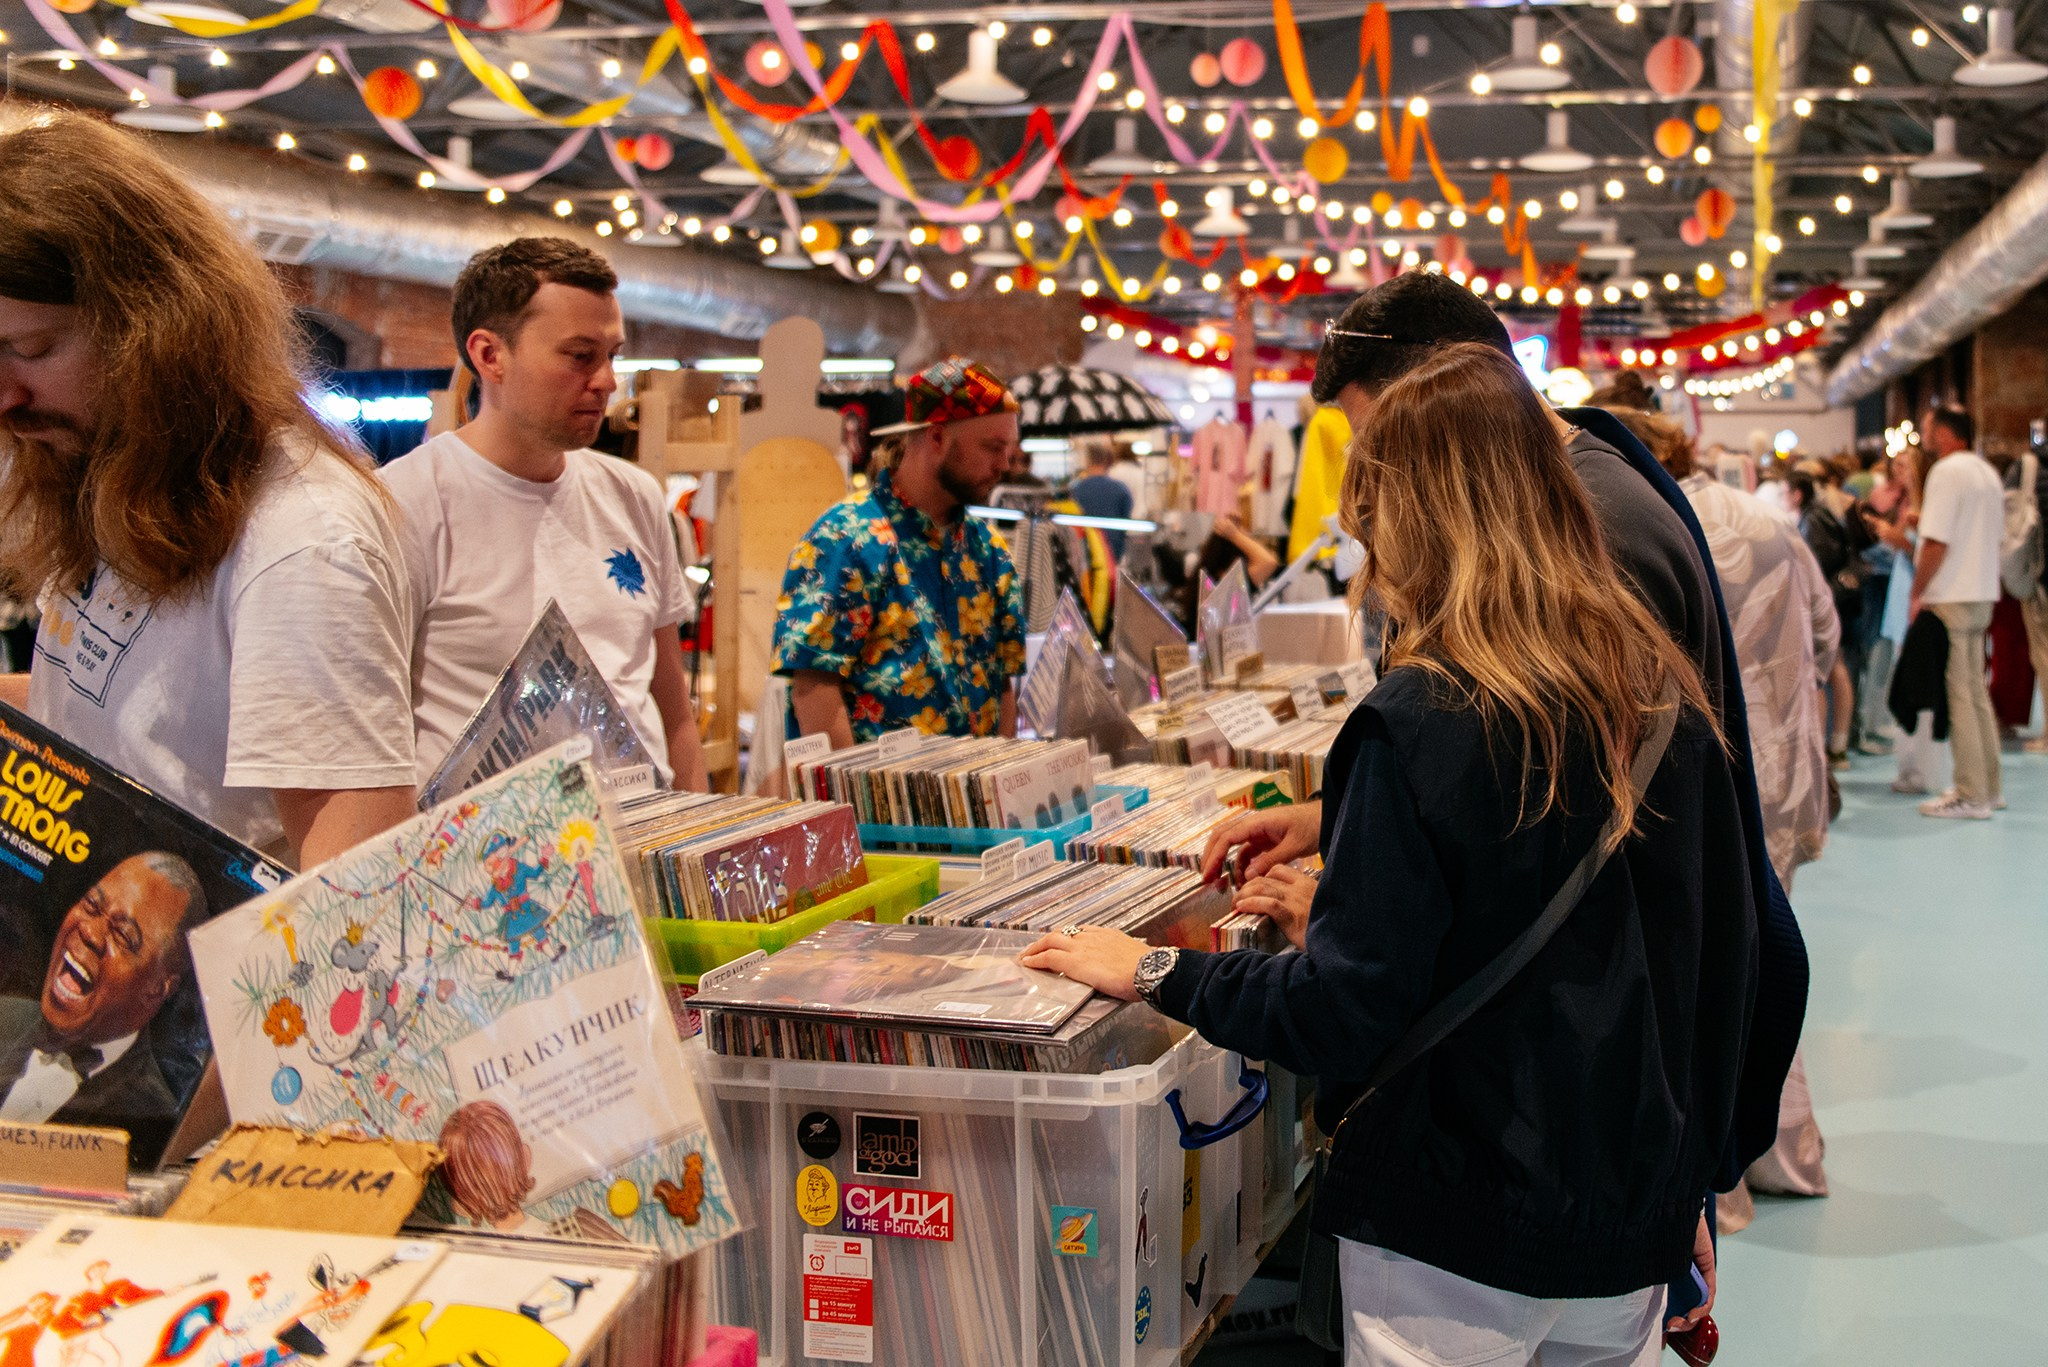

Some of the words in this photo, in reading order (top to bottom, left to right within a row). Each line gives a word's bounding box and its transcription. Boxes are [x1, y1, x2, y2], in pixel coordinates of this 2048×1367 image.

[513, 639, 579, 738] PARK
[42, 745, 91, 786] Presents
[613, 772, 648, 788] ССИКА
[1045, 759, 1061, 776] THE
[1060, 749, 1085, 769] WORKS
[2, 750, 84, 813] LOUIS
[1002, 769, 1032, 794] QUEEN
[0, 785, 91, 863] TRONG
[1028, 849, 1049, 873] MUSIC
[473, 994, 644, 1091] ЩЕЛКУНЧИК
[857, 1117, 917, 1153] lamb
[210, 1158, 395, 1198] КЛАССИКА
[859, 1149, 871, 1158] of
[868, 1150, 915, 1174] god
[845, 1187, 949, 1224] СИДИ
[846, 1216, 857, 1230] И
[862, 1217, 879, 1232] НЕ
[884, 1220, 949, 1238] РЫПАЙСЯ
[838, 1312, 857, 1320] минут
